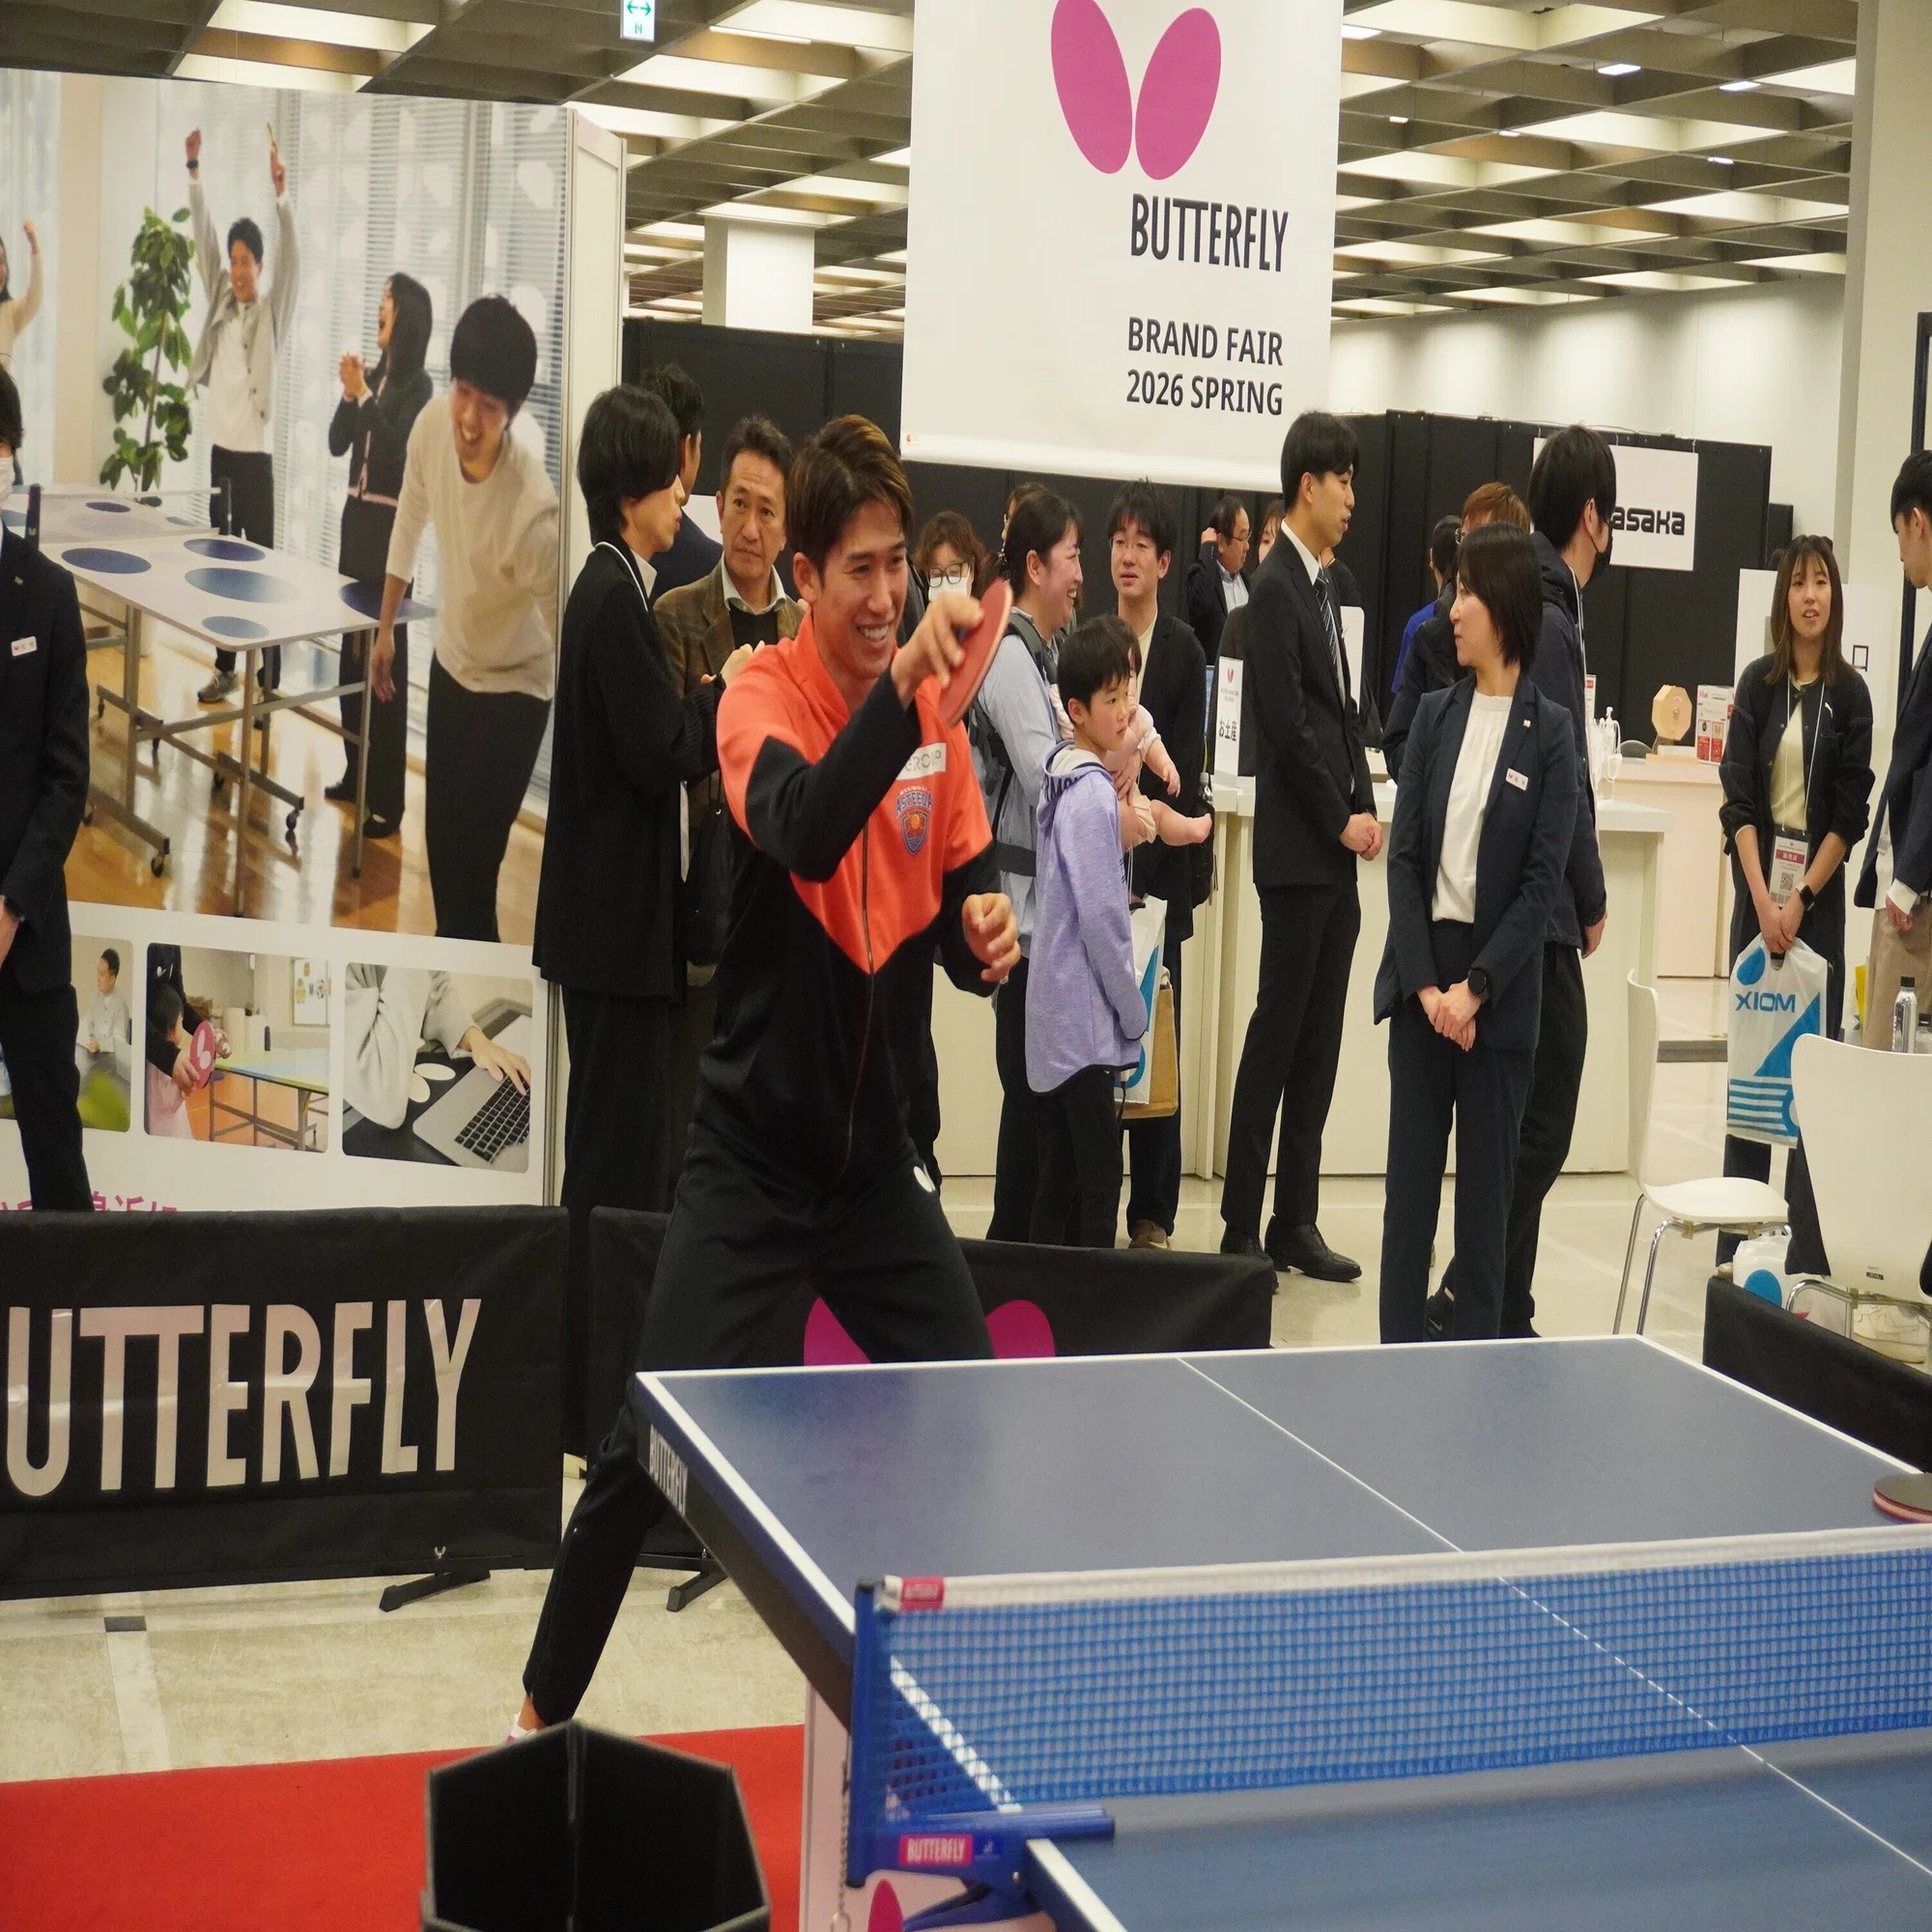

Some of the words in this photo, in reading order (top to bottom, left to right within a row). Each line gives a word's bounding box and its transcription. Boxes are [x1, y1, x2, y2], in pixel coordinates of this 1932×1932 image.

[1130, 193, 1289, 272] BUTTERFLY
[1128, 316, 1218, 359] BRAND
[1226, 327, 1283, 366] FAIR
[1126, 368, 1183, 407] 2026
[1190, 375, 1283, 415] SPRING
[1735, 991, 1796, 1012] XIOM
[7, 1298, 482, 1496] UTTERFLY
[907, 1837, 966, 1863] BUTTERFLY
